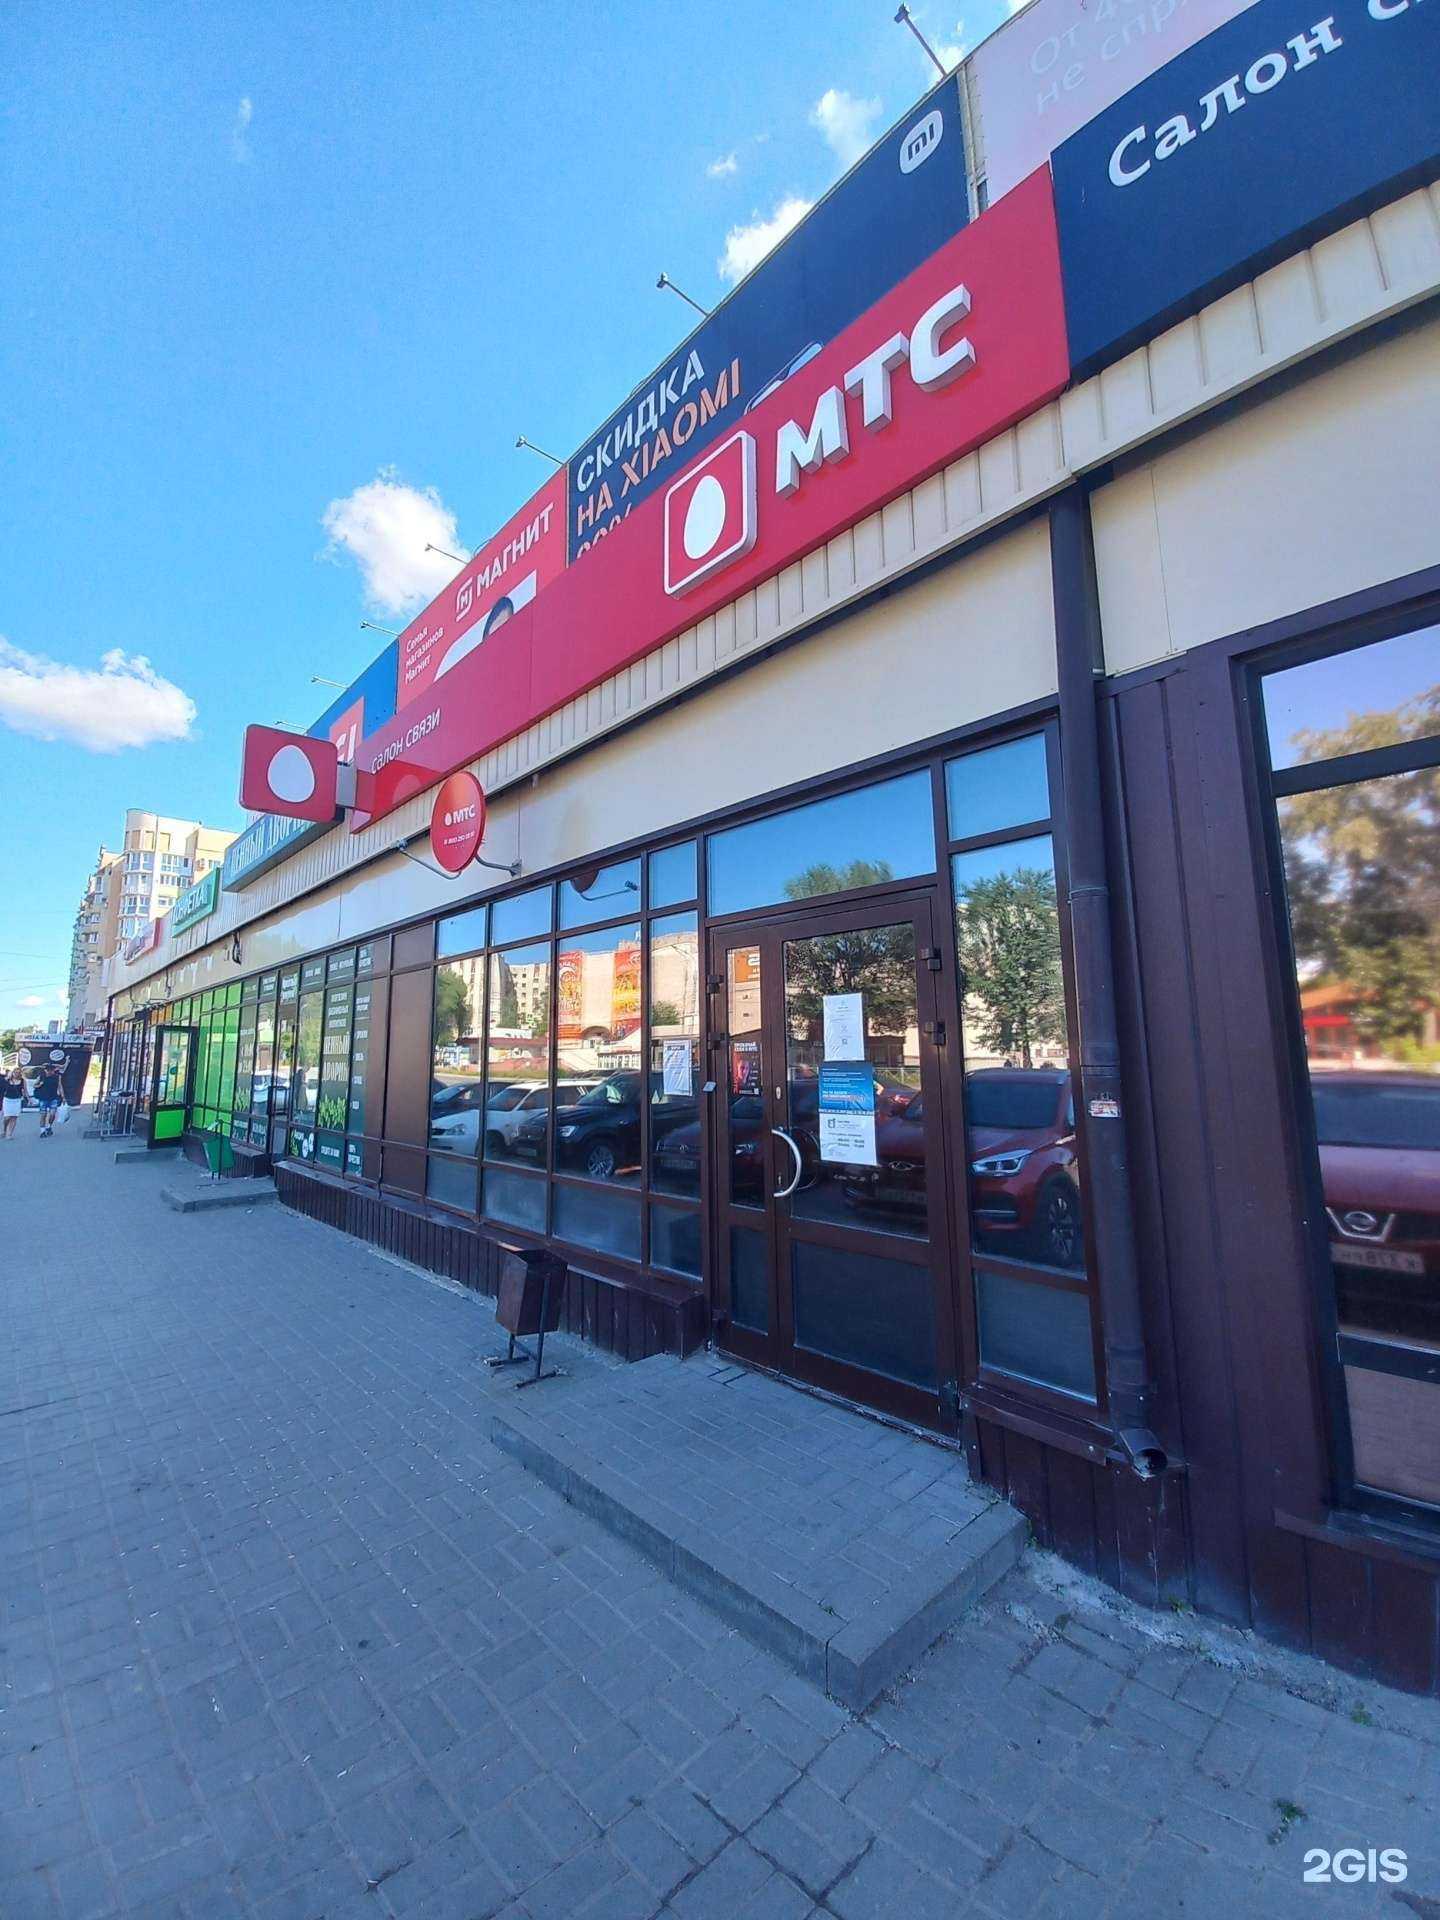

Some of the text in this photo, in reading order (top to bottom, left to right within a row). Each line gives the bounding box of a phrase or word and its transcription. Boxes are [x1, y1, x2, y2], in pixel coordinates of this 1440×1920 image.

[1108, 16, 1344, 188] Салон
[576, 349, 706, 493] СКИДКА
[776, 283, 977, 500] МТС
[577, 481, 615, 537] НА
[620, 357, 742, 499] XIAOMI
[476, 502, 556, 599] МАГНИТ
[405, 626, 428, 653] Семья
[405, 626, 444, 669] магазинов
[405, 654, 432, 684] Магнит
[453, 803, 476, 825] МТС
